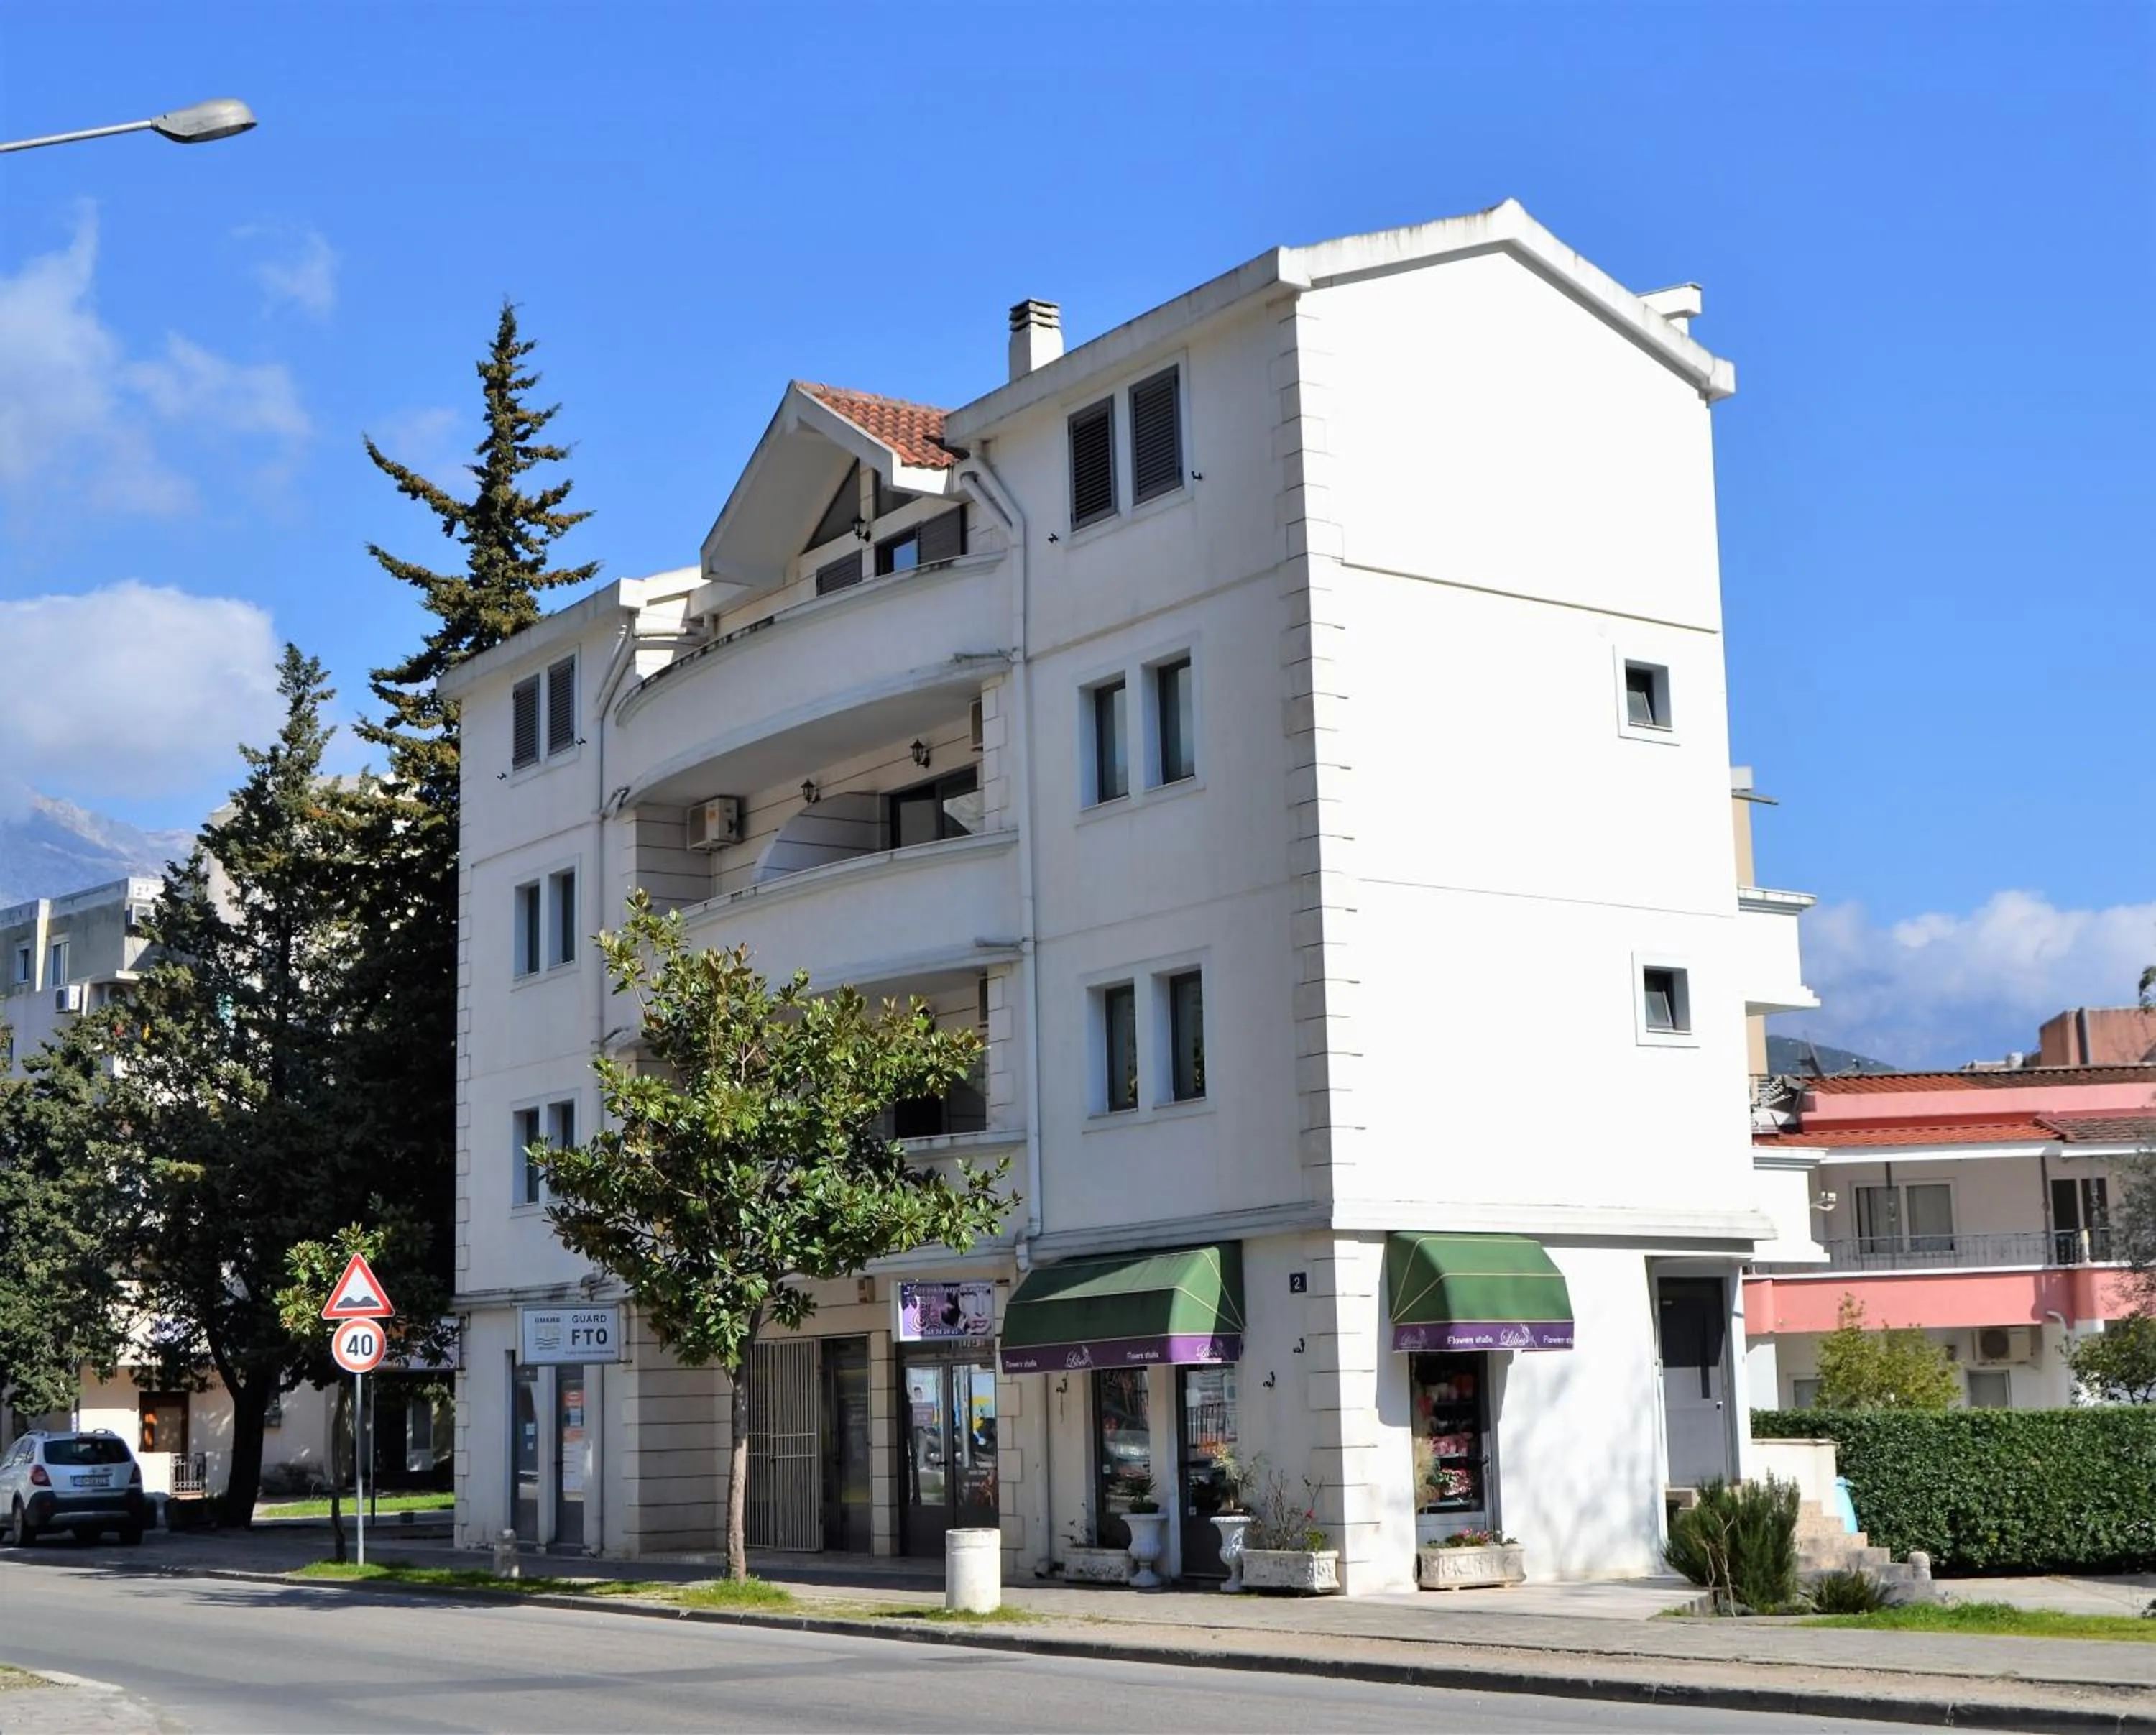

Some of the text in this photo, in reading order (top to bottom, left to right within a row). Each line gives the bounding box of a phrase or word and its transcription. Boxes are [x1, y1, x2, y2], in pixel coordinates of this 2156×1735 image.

[1294, 1276, 1300, 1289] 2
[571, 1315, 607, 1323] GUARD
[571, 1328, 608, 1346] FTO
[346, 1334, 373, 1356] 40
